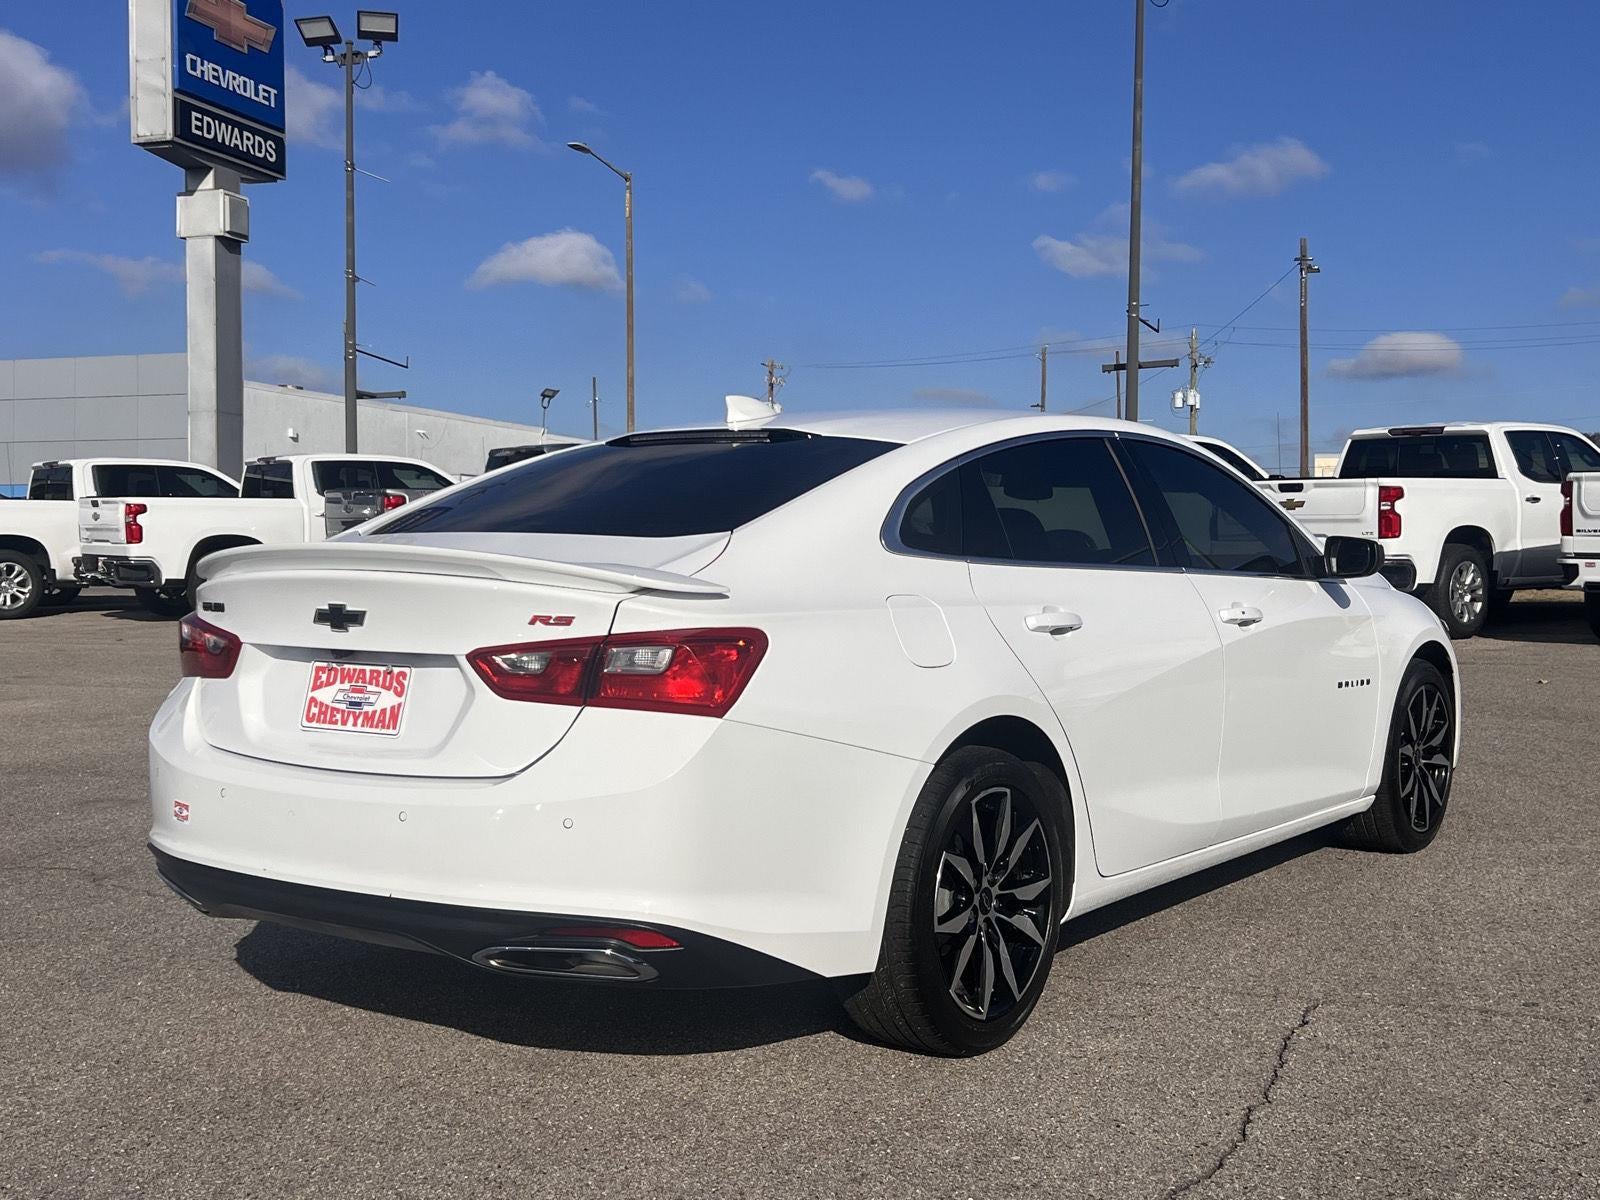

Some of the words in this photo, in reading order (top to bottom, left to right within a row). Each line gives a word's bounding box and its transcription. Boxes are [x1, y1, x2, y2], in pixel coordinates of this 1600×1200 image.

[185, 53, 278, 108] CHEVROLET
[191, 110, 277, 163] EDWARDS
[527, 614, 576, 627] RS
[311, 665, 408, 698] EDWARDS
[342, 693, 372, 701] Chevrolet
[1337, 678, 1371, 689] MALIBU
[305, 695, 403, 730] CHEVYMAN
